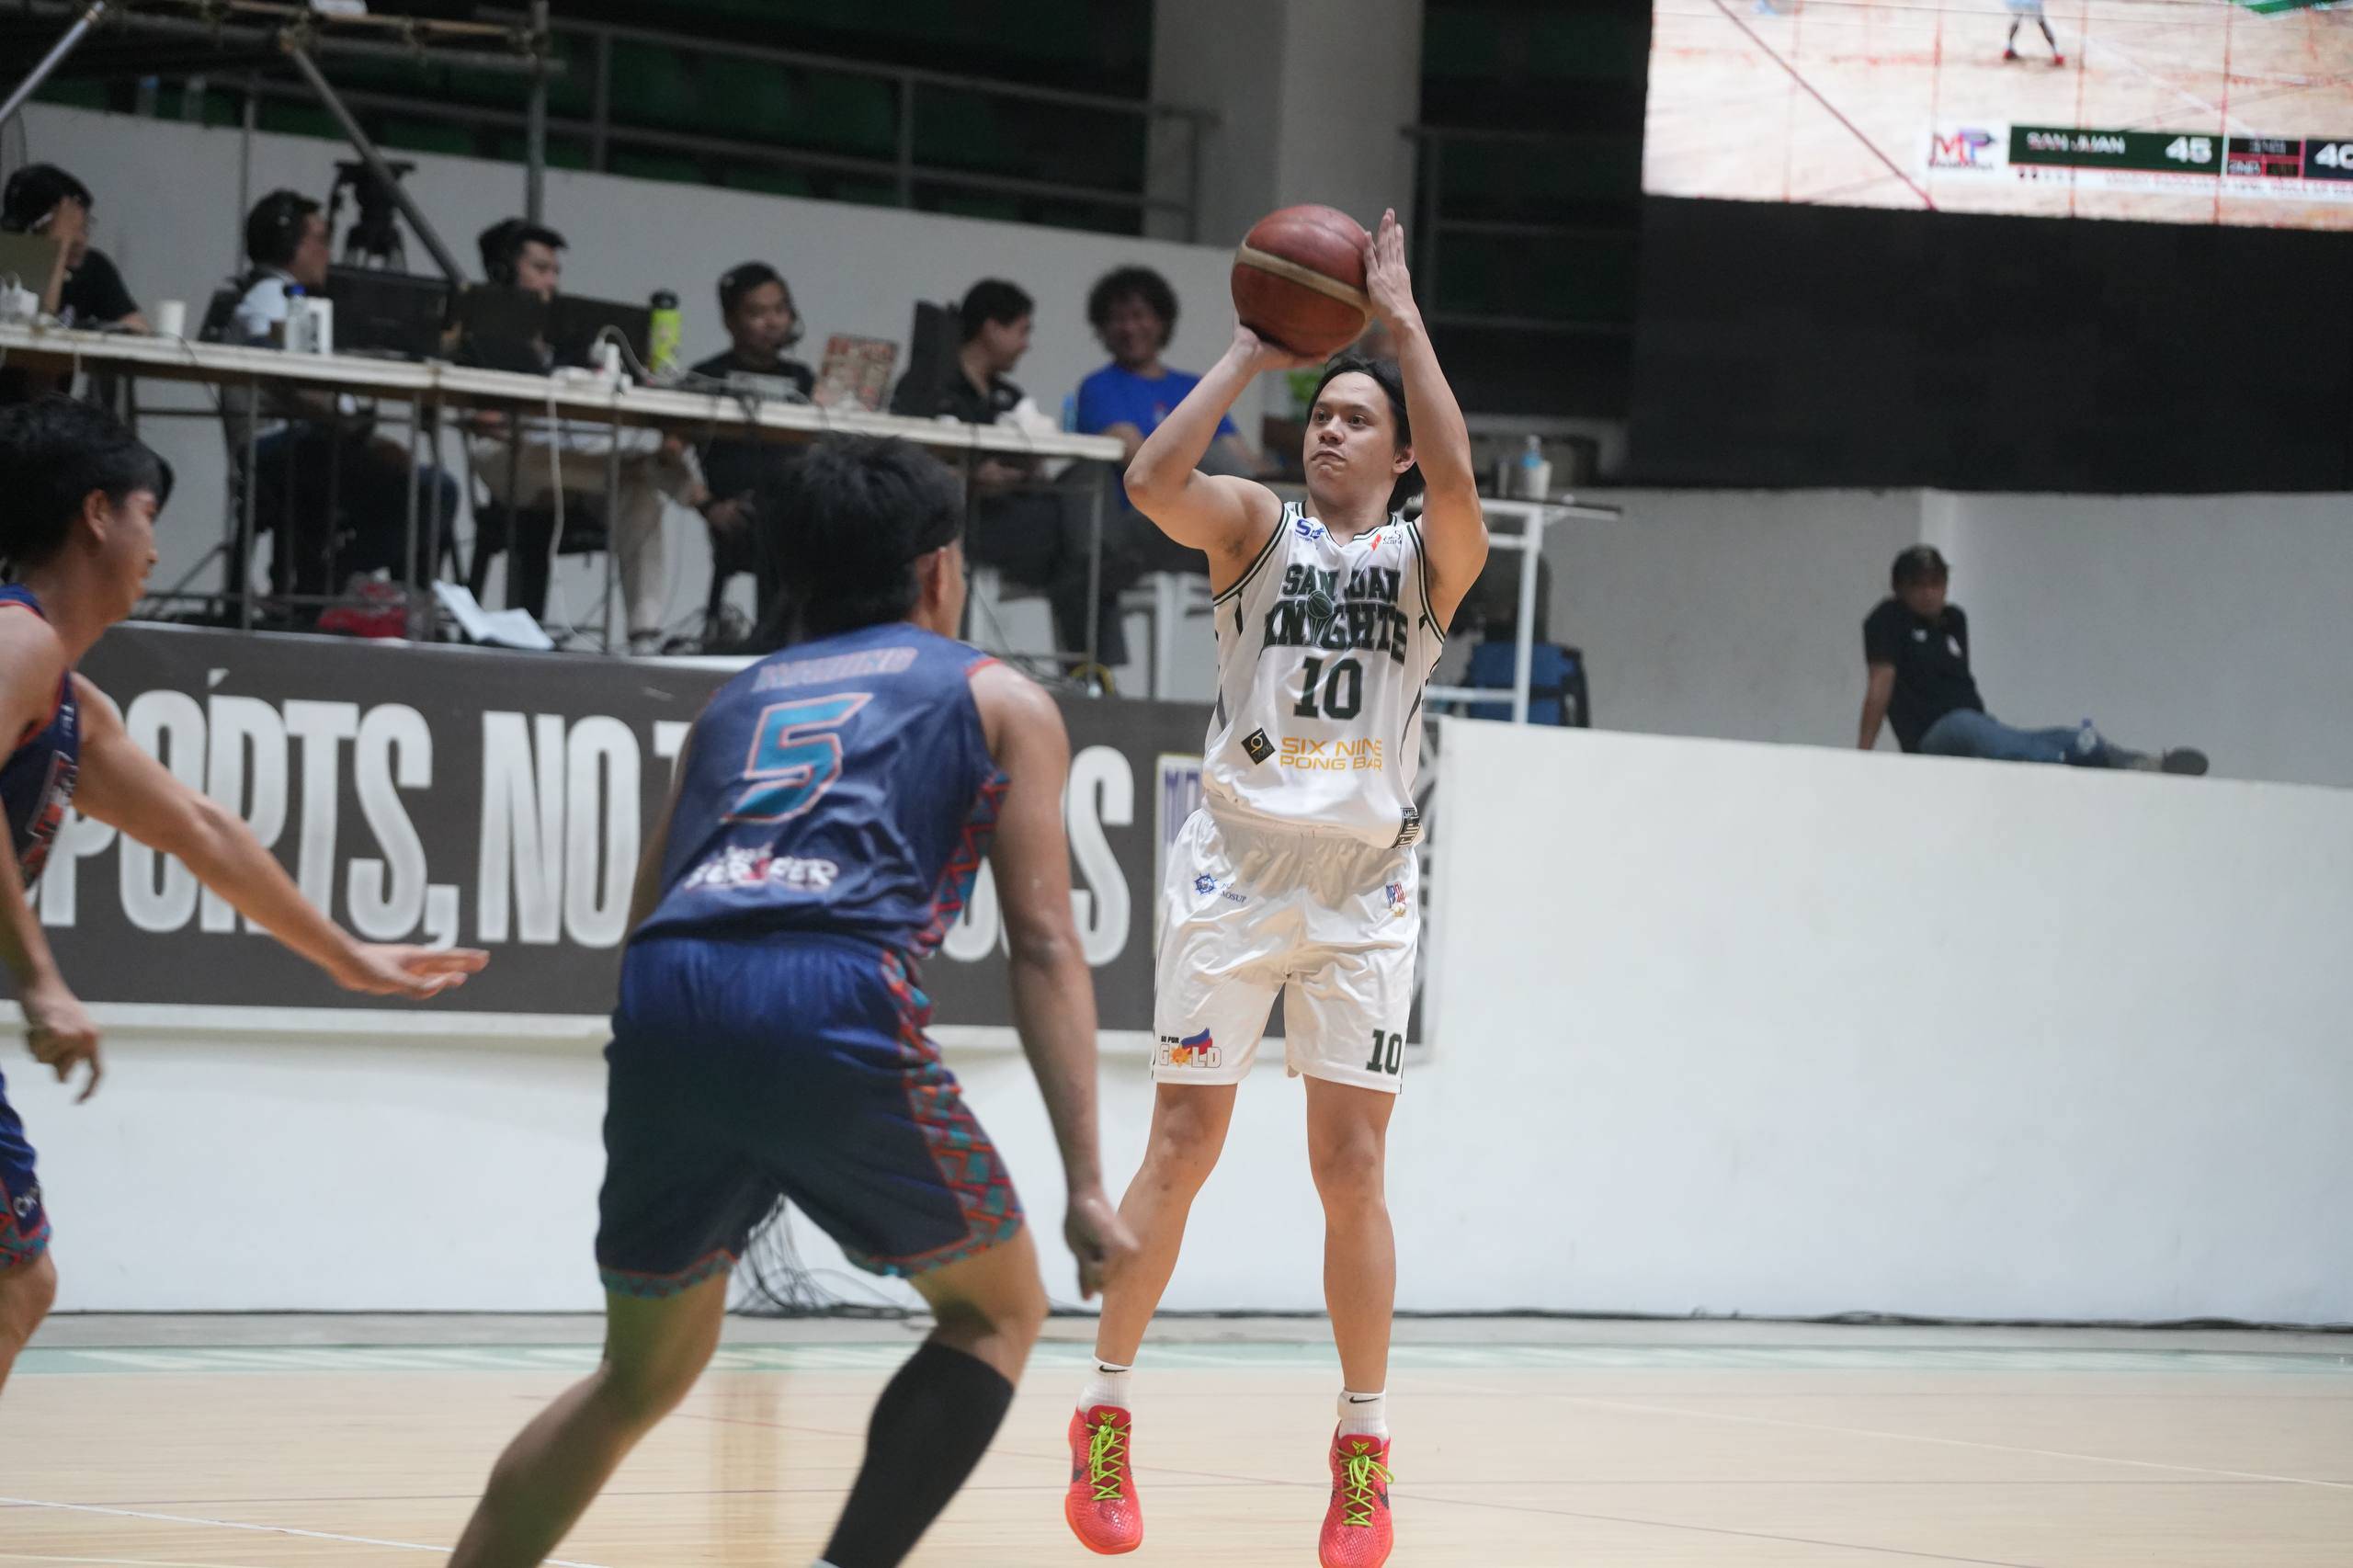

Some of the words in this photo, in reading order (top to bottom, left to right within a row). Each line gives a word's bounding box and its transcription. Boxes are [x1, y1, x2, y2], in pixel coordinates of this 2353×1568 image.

[2027, 131, 2068, 151] SAN
[2165, 136, 2212, 164] 45
[1282, 563, 1340, 602] SAN
[1294, 656, 1362, 721] 10
[720, 692, 873, 824] 5
[1280, 737, 1327, 756] SIX
[1280, 755, 1346, 770] PONG
[478, 710, 641, 948] NO
[1366, 1028, 1403, 1076] 10
